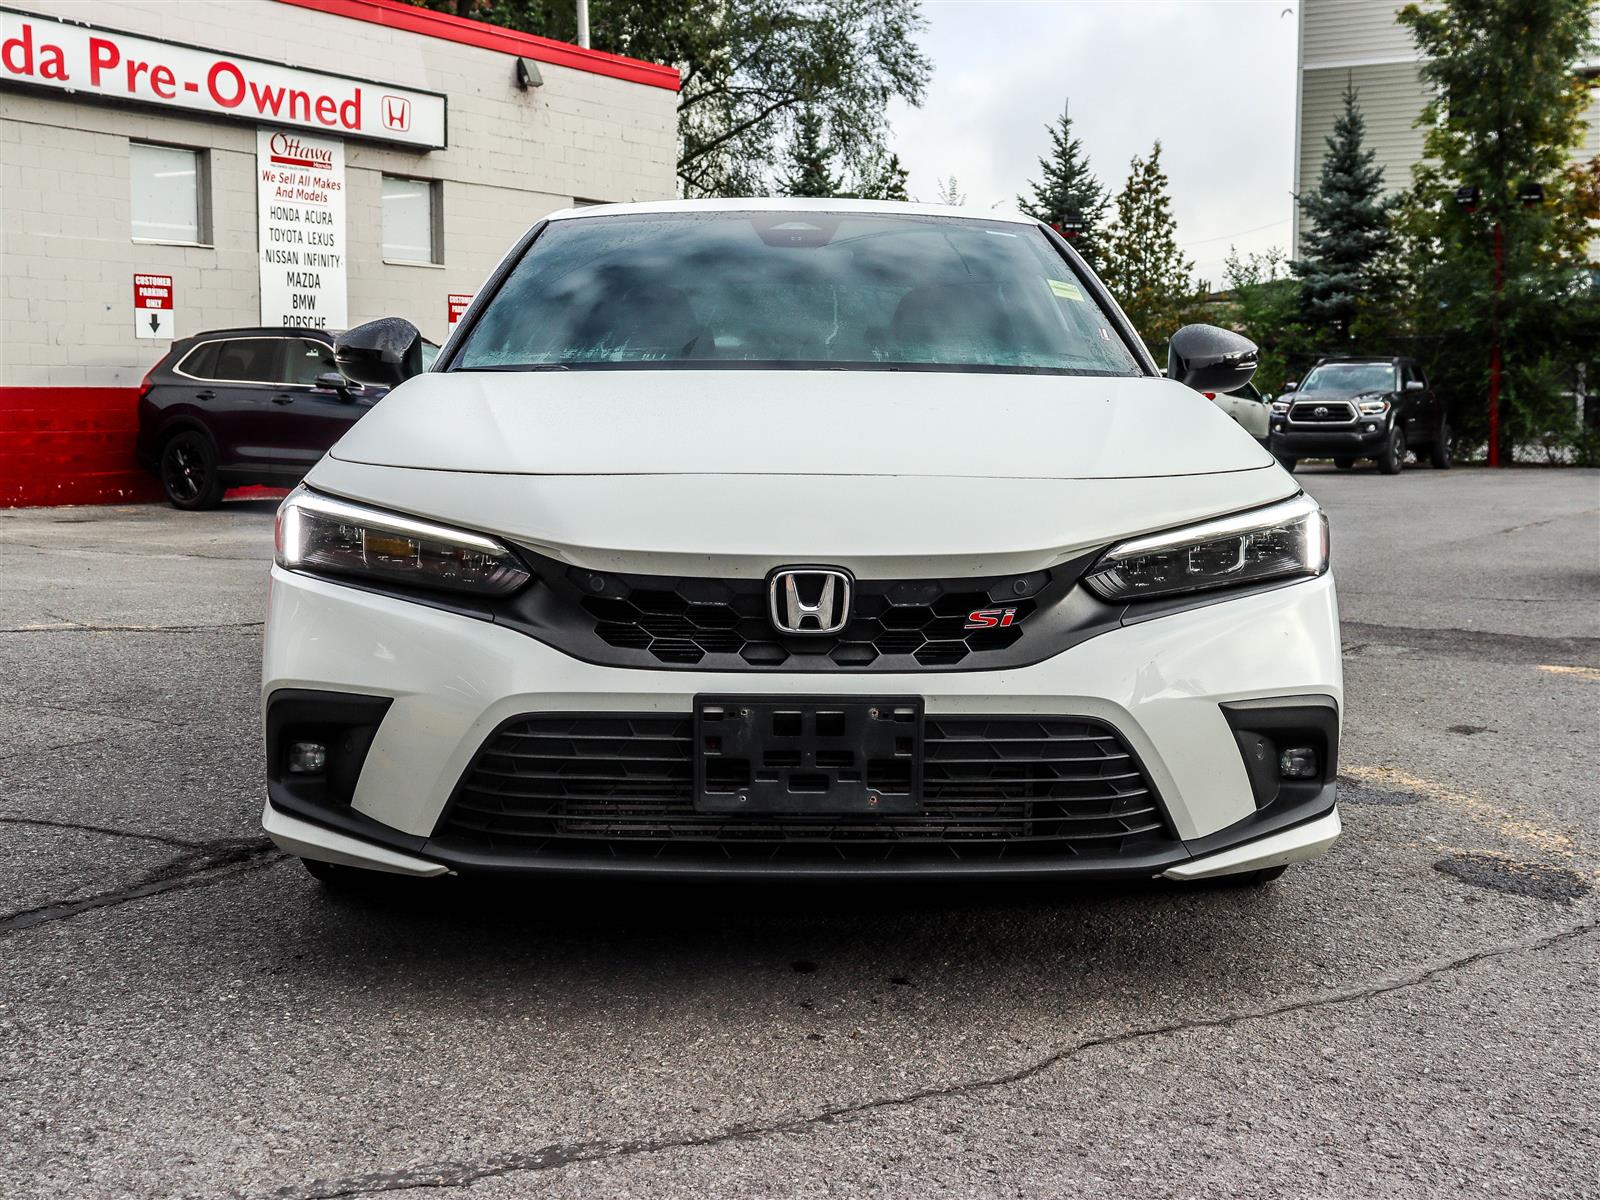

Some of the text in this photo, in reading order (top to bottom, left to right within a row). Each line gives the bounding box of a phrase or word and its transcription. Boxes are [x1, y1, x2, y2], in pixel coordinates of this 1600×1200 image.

[89, 37, 361, 130] Pre-Owned
[270, 132, 332, 161] Ottawa
[262, 170, 341, 191] We Sell All Makes
[275, 186, 328, 203] And Models
[270, 206, 333, 225] HONDA ACURA
[269, 227, 335, 247] TOYOTA LEXUS
[265, 249, 340, 268] NISSAN INFINITY
[135, 275, 172, 287] CUSTOMER
[286, 271, 321, 289] MAZDA
[139, 287, 169, 297] PARKING
[145, 299, 162, 308] ONLY
[292, 294, 316, 310] BMW
[283, 315, 326, 328] PORSCHE
[964, 609, 1017, 629] Si
